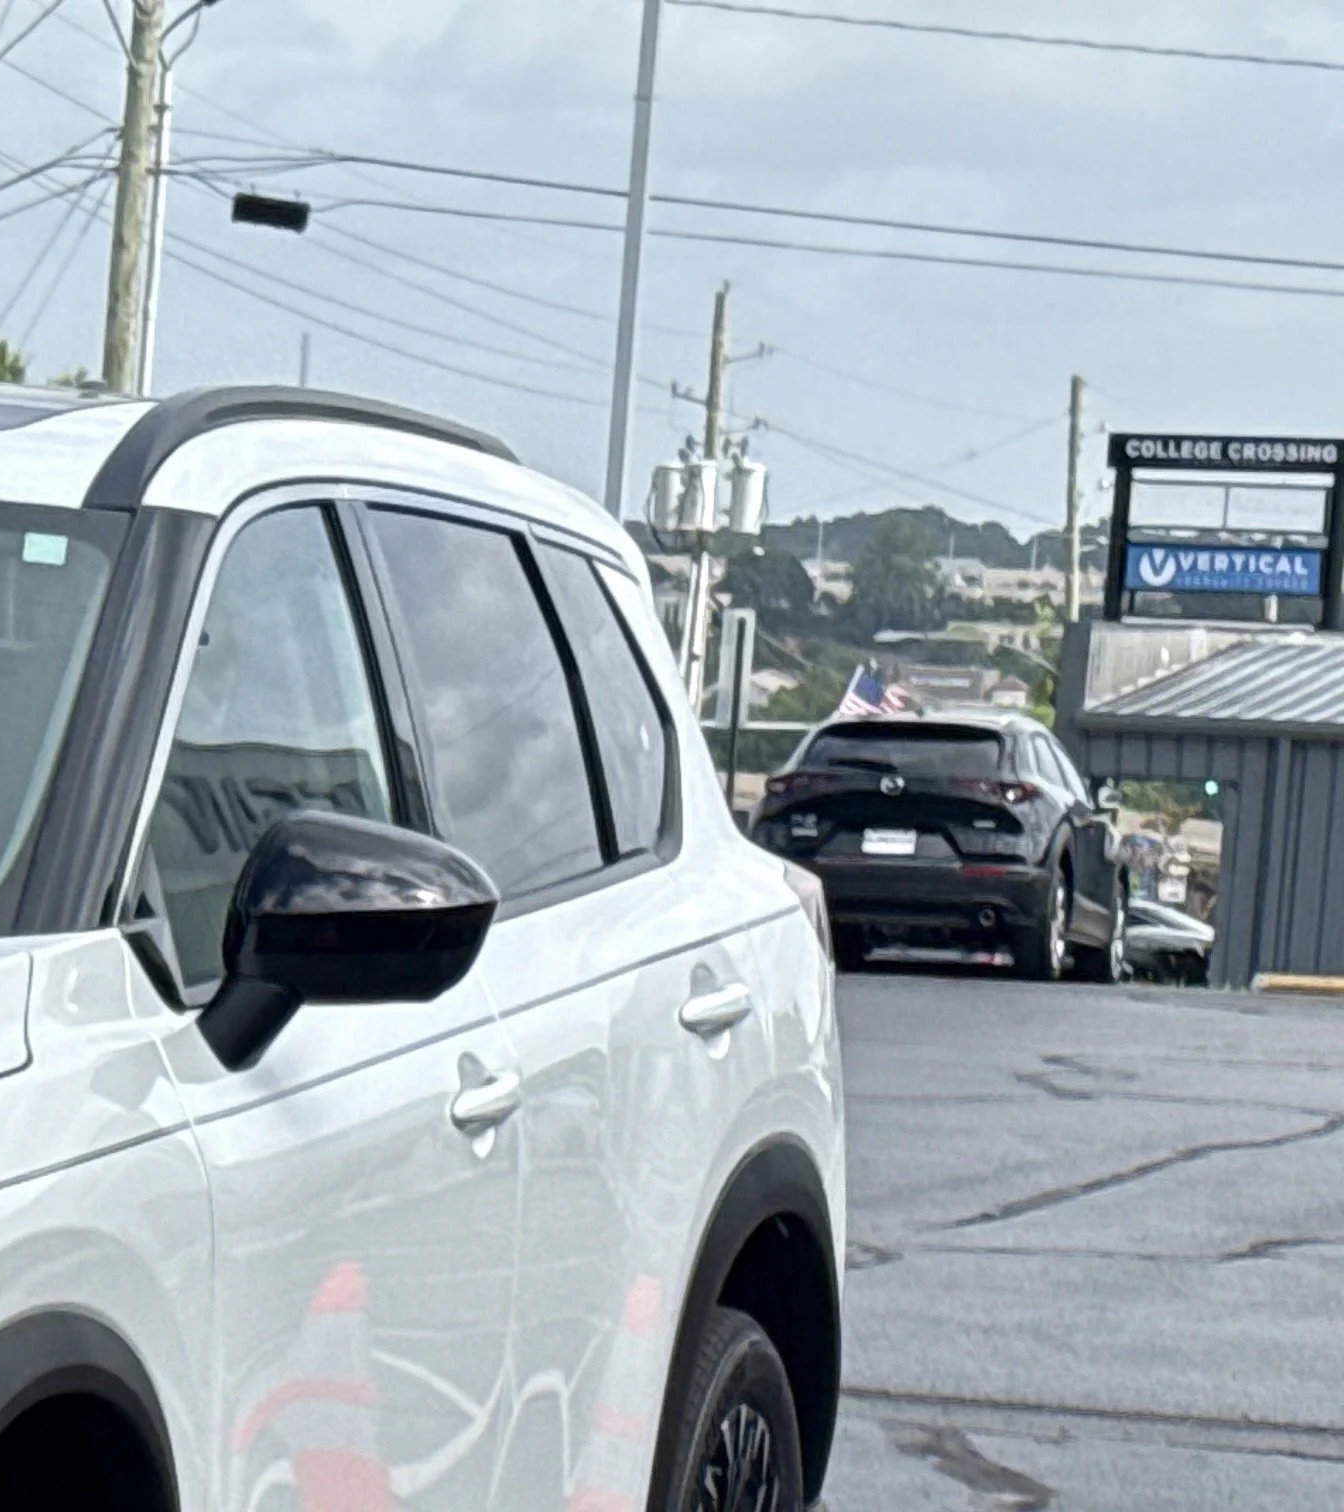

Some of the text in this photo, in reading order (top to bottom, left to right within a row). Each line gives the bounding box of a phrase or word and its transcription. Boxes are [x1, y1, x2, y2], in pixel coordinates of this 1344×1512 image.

[1125, 439, 1338, 463] COLLEGE CROSSING
[1178, 551, 1308, 575] VERTICAL
